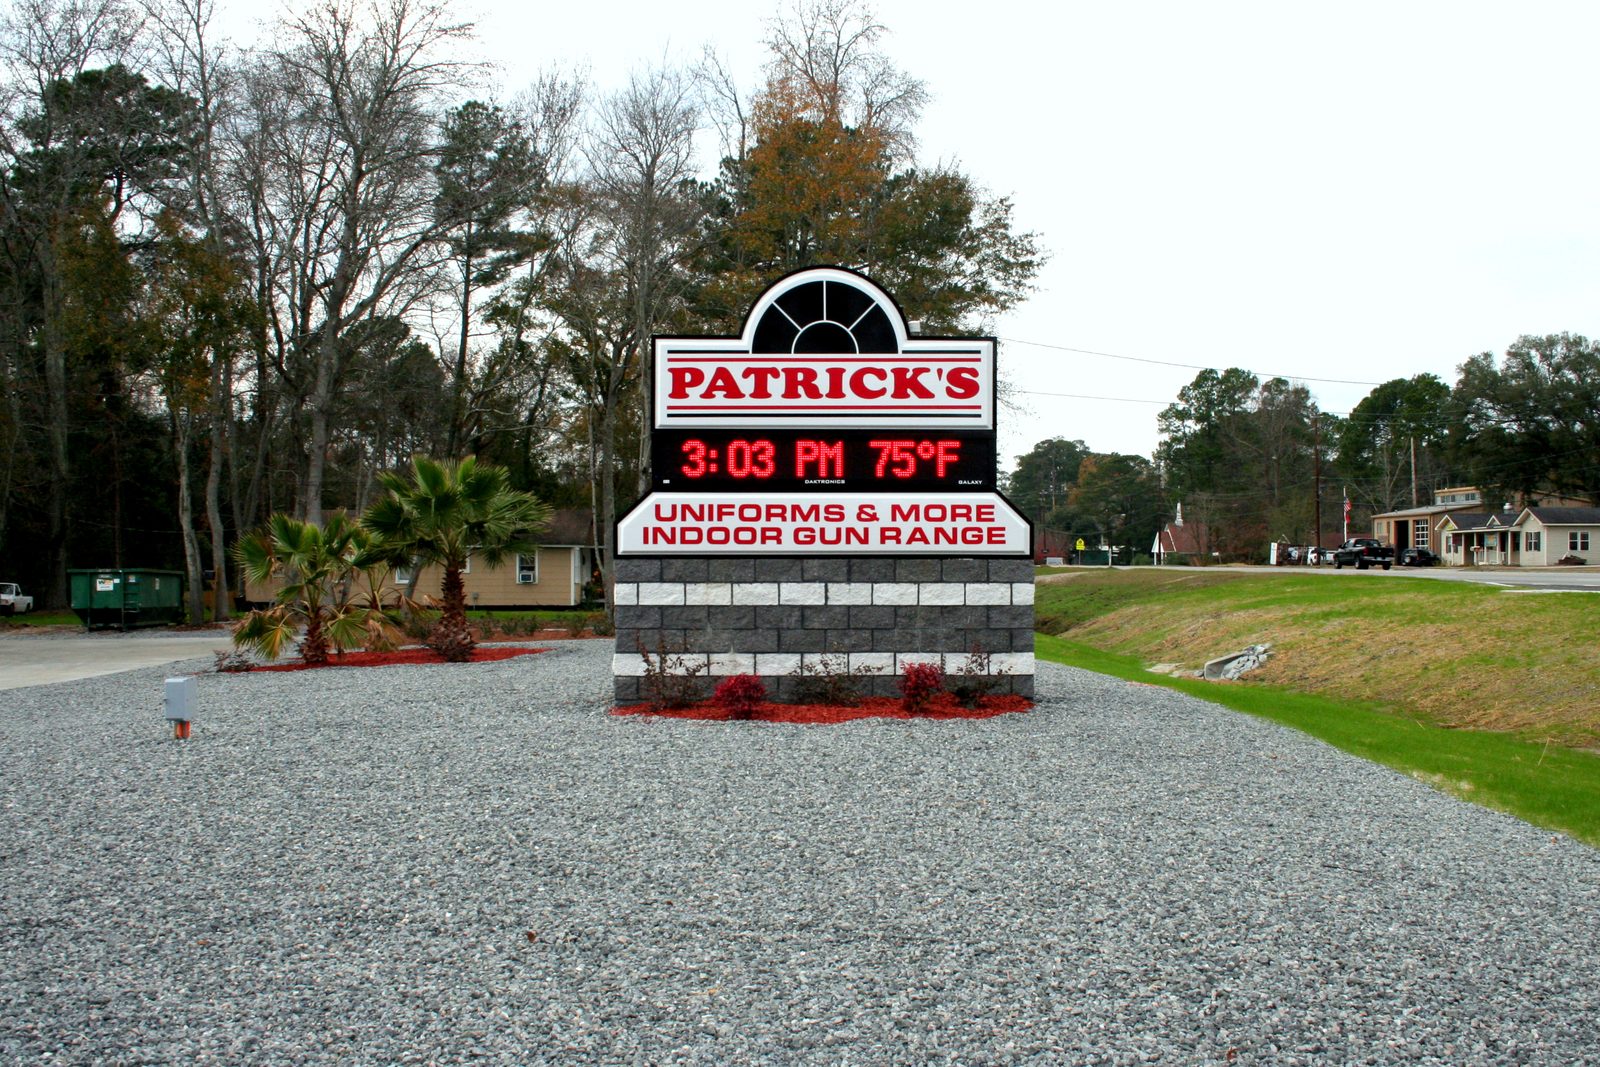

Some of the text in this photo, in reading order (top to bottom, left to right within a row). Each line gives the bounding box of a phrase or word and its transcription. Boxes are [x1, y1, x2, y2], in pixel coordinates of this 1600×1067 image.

[667, 366, 980, 400] PATRICK'S
[681, 439, 776, 479] 3:03
[794, 439, 845, 479] PM
[655, 503, 996, 523] UNIFORMS & MORE
[643, 526, 1006, 545] INDOOR GUN RANGE
